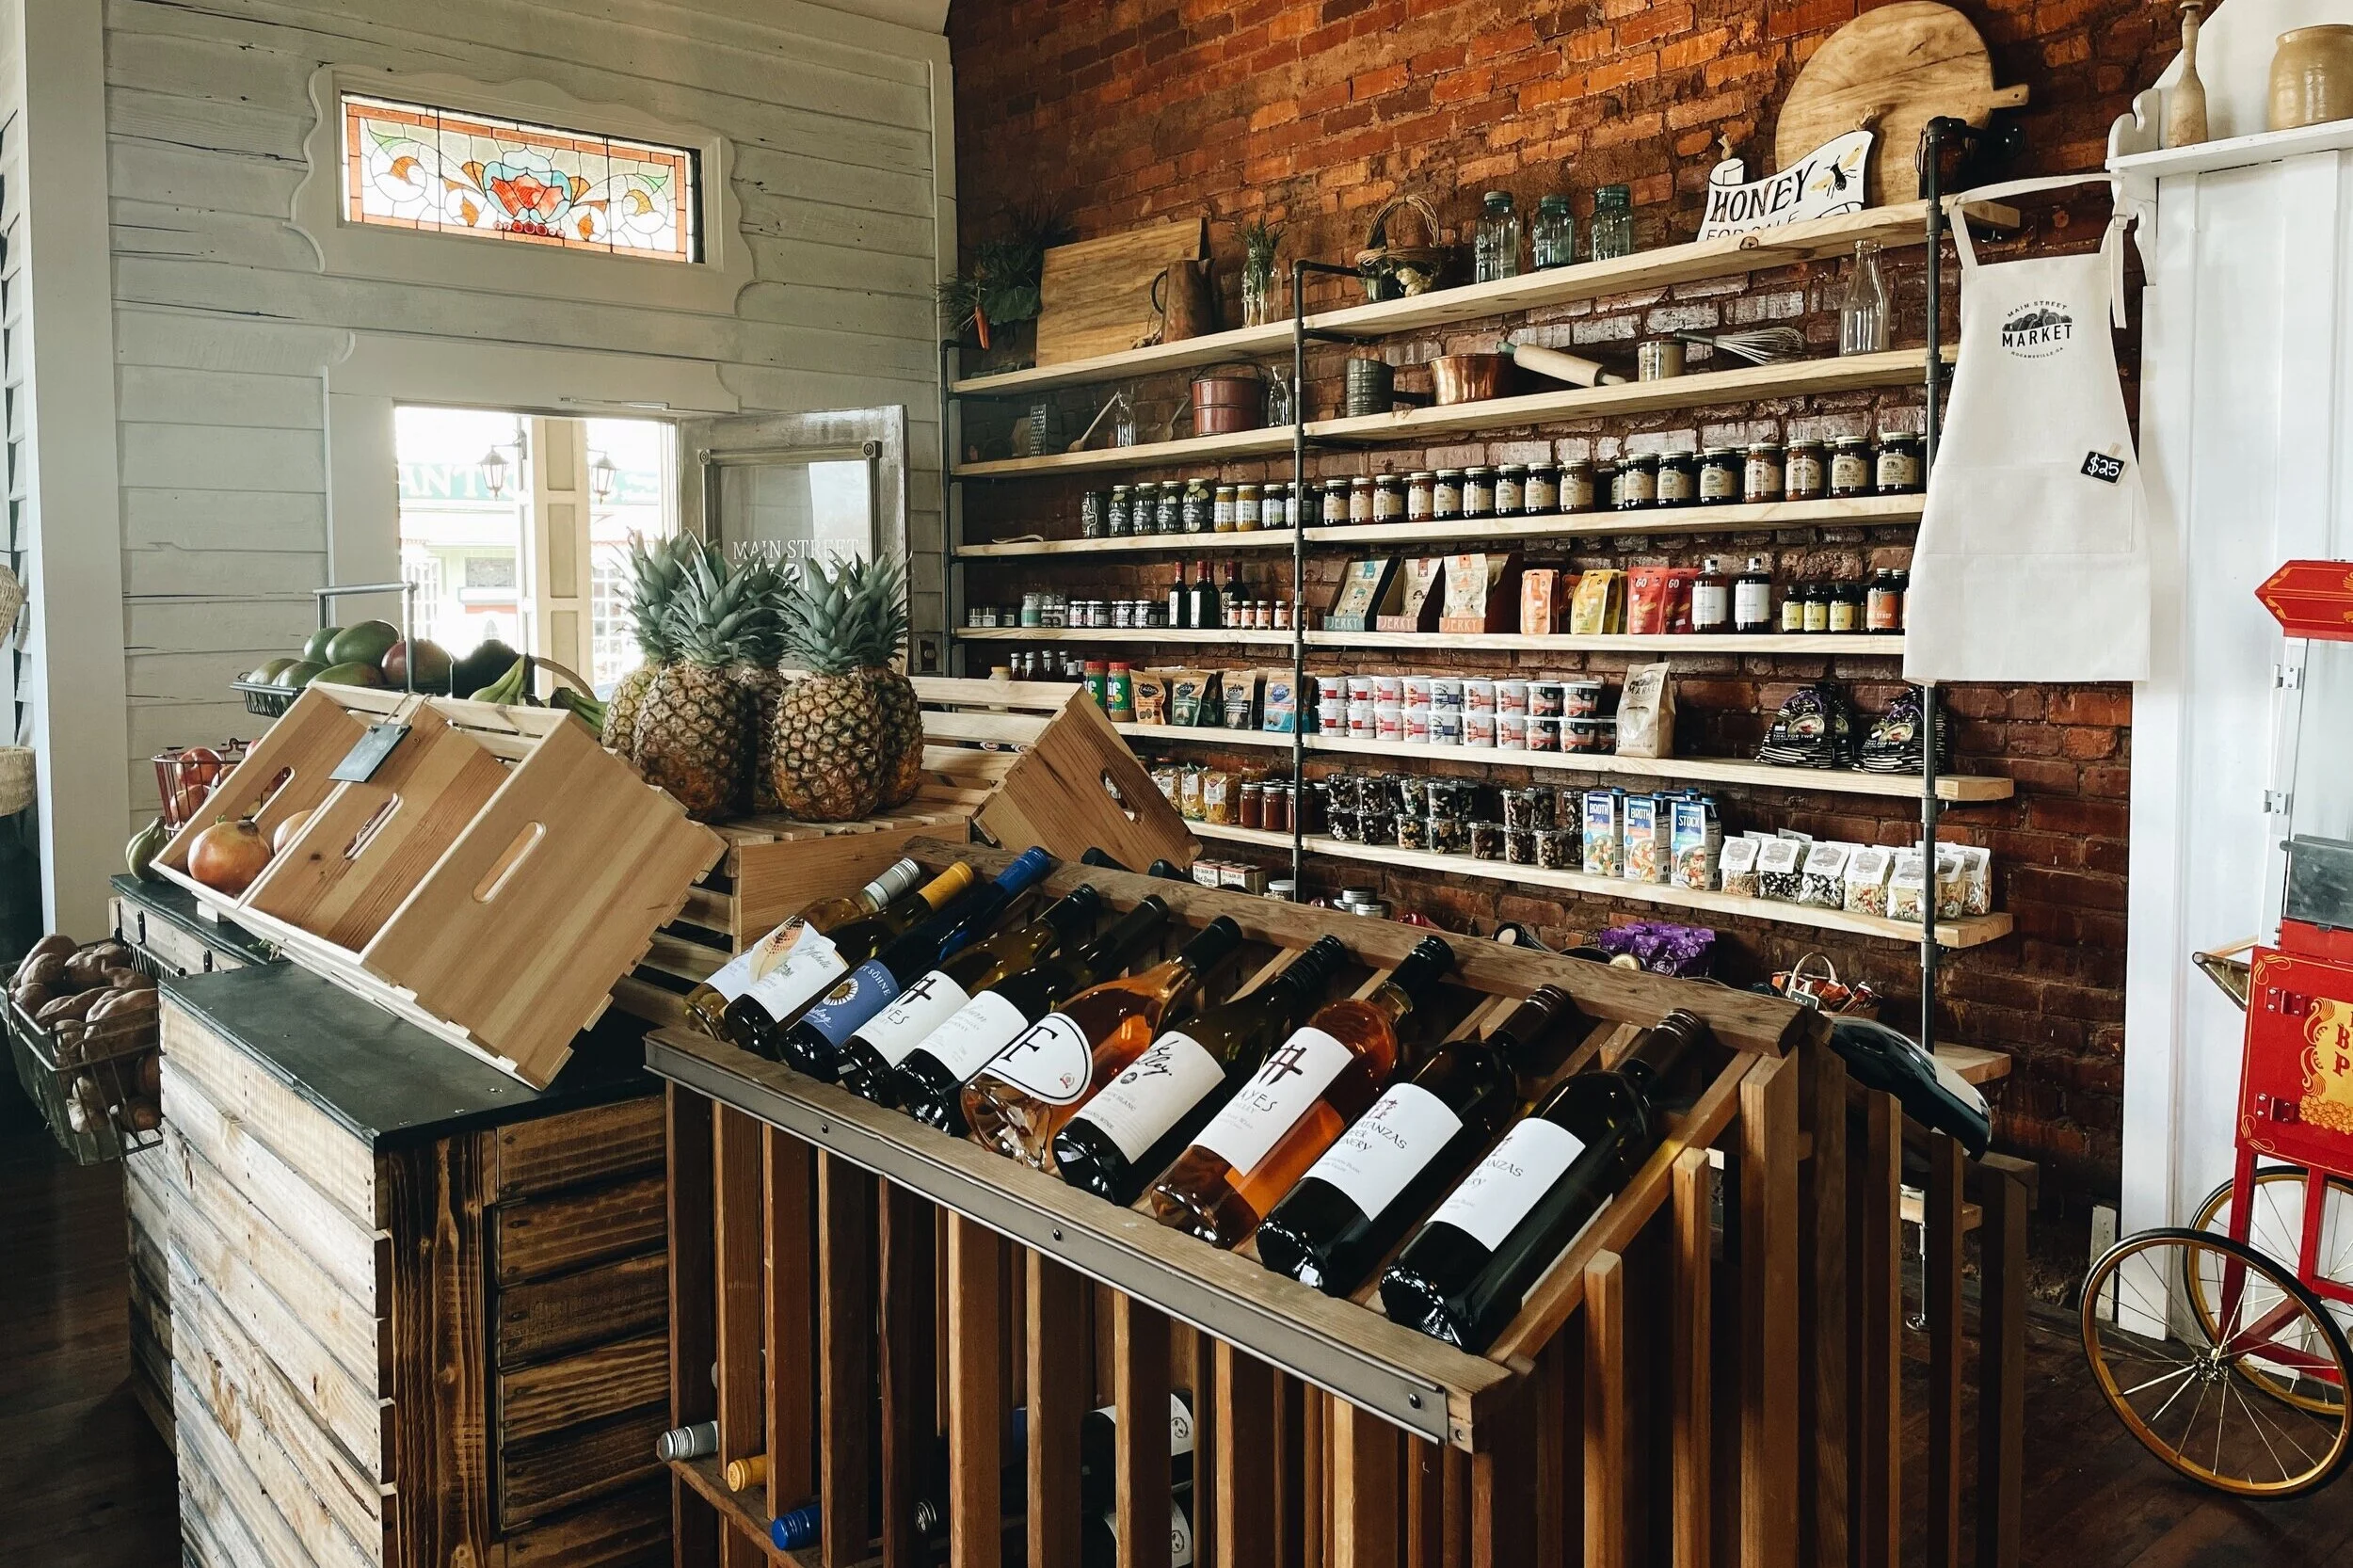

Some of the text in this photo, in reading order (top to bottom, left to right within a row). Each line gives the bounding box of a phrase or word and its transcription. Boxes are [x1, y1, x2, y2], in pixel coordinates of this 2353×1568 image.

[1708, 159, 1818, 223] HONEY
[2007, 300, 2068, 317] MAIN STREET
[2002, 324, 2073, 347] MARKET
[2087, 453, 2120, 476] $25
[732, 538, 859, 561] MAIN STREET
[1328, 617, 1359, 630] JERKY
[1381, 617, 1412, 630] JERKY
[1444, 619, 1477, 632] JERKY
[1627, 683, 1659, 696] MARKET
[1589, 803, 1609, 816] BROTH
[1630, 808, 1651, 820] BROTH
[1678, 815, 1700, 828] STOCK
[867, 968, 891, 996] SÖHNE
[1238, 1089, 1278, 1112] AYES
[1357, 1120, 1408, 1150] ATANZAS
